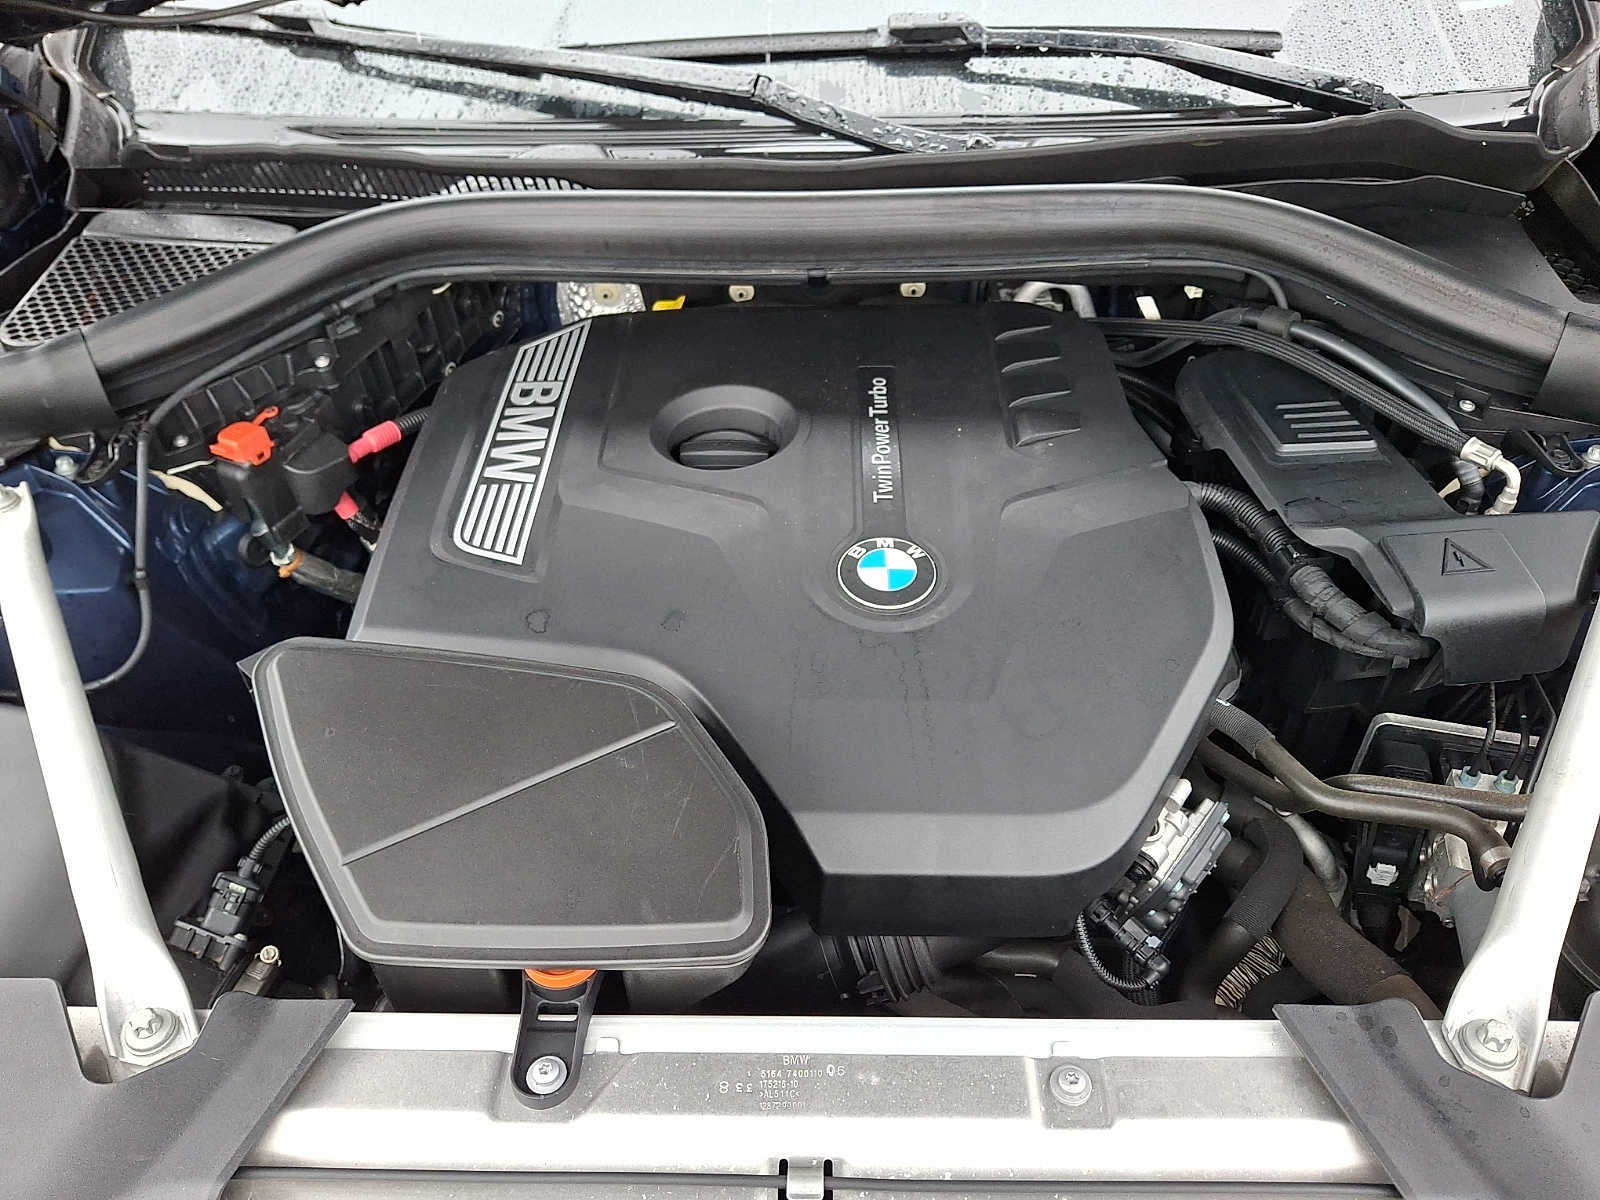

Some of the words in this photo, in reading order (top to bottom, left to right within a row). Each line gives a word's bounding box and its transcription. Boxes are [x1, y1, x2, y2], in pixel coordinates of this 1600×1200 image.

[868, 377, 888, 417] Turbo
[483, 381, 563, 483] BMW
[848, 538, 926, 559] BMW
[783, 1055, 810, 1066] BMW
[826, 1064, 846, 1077] 06
